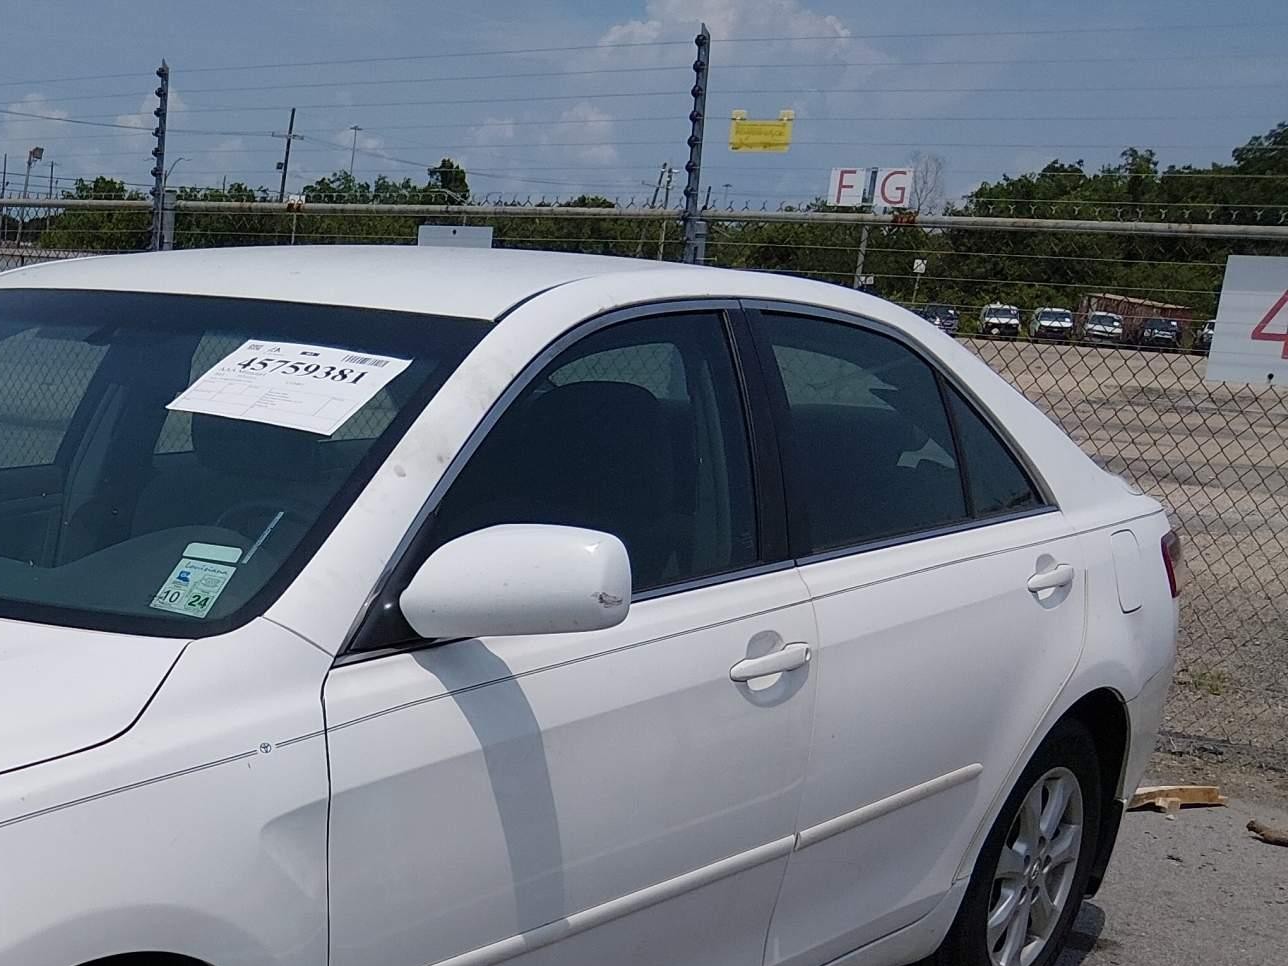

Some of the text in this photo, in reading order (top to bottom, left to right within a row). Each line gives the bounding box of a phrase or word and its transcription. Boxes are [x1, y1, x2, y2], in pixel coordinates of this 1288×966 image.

[836, 169, 907, 205] F G
[237, 356, 369, 385] 45759381
[162, 589, 209, 608] 10 24
